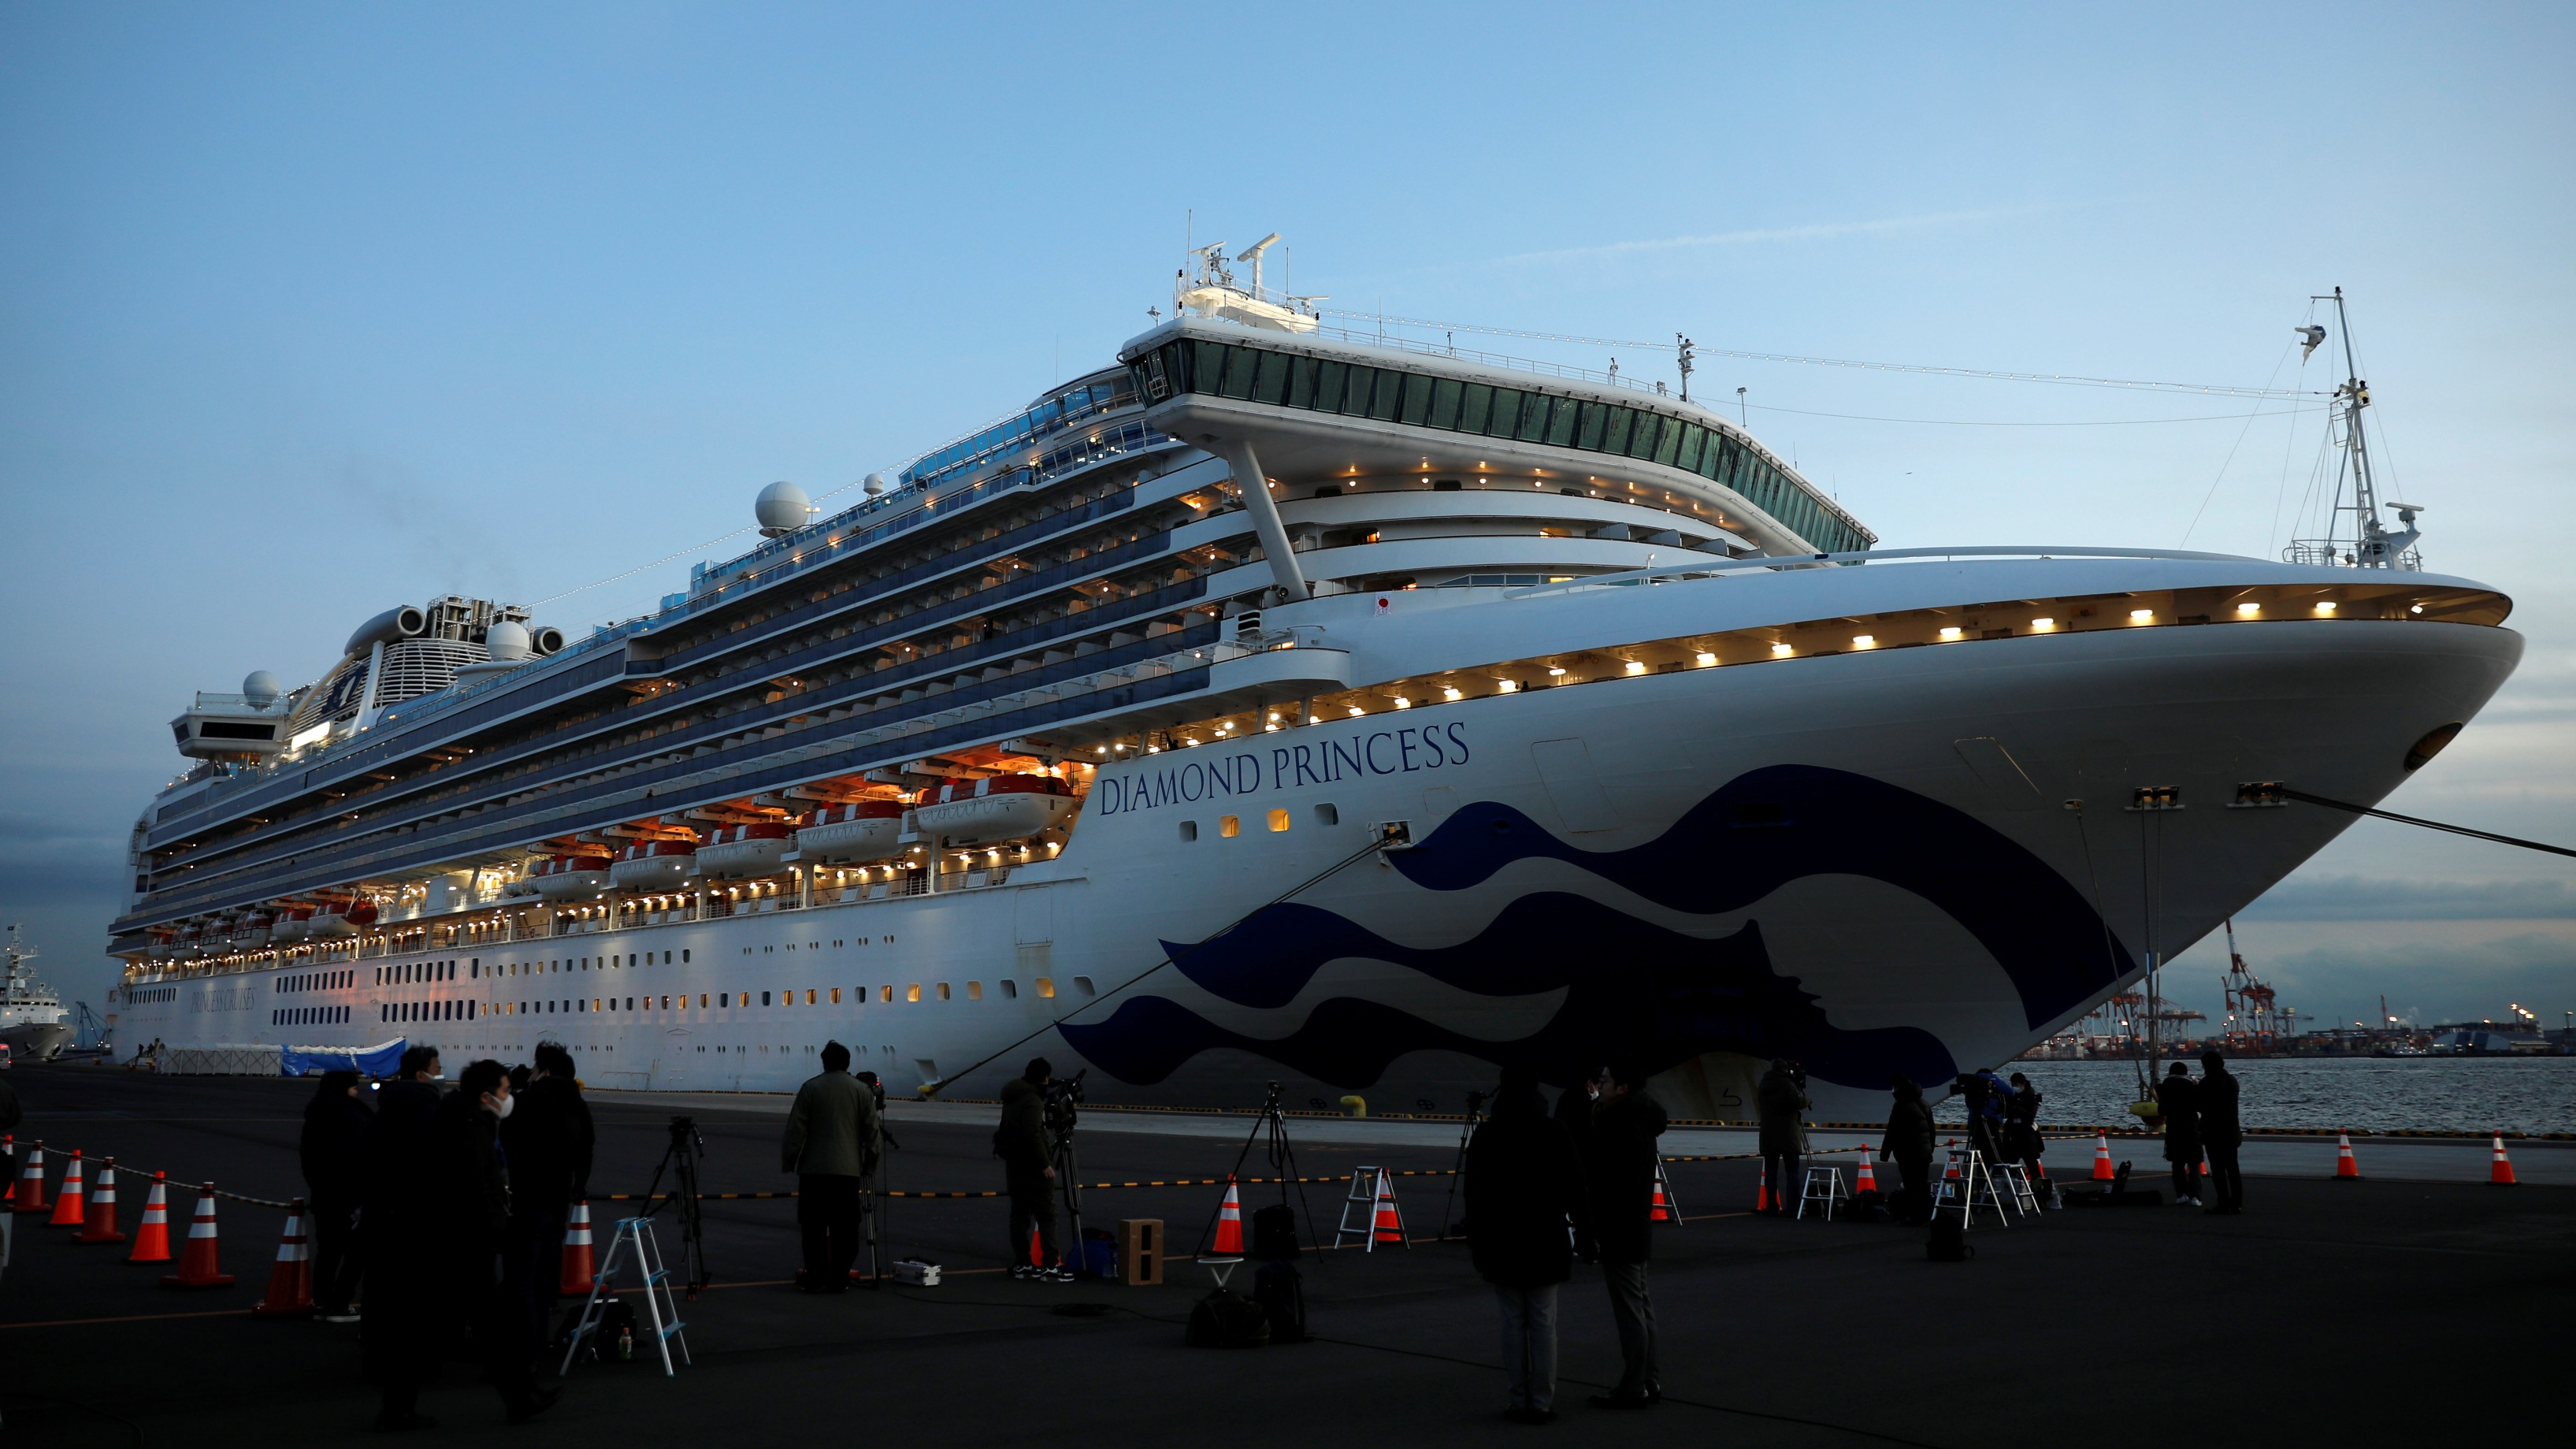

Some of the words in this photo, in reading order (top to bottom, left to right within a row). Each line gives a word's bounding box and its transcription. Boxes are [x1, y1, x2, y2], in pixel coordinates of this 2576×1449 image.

[1100, 753, 1260, 816] DIAMOND
[1272, 722, 1470, 790] PRINCESS
[191, 990, 223, 1013] PRINCESS
[224, 987, 256, 1011] CRUISES
